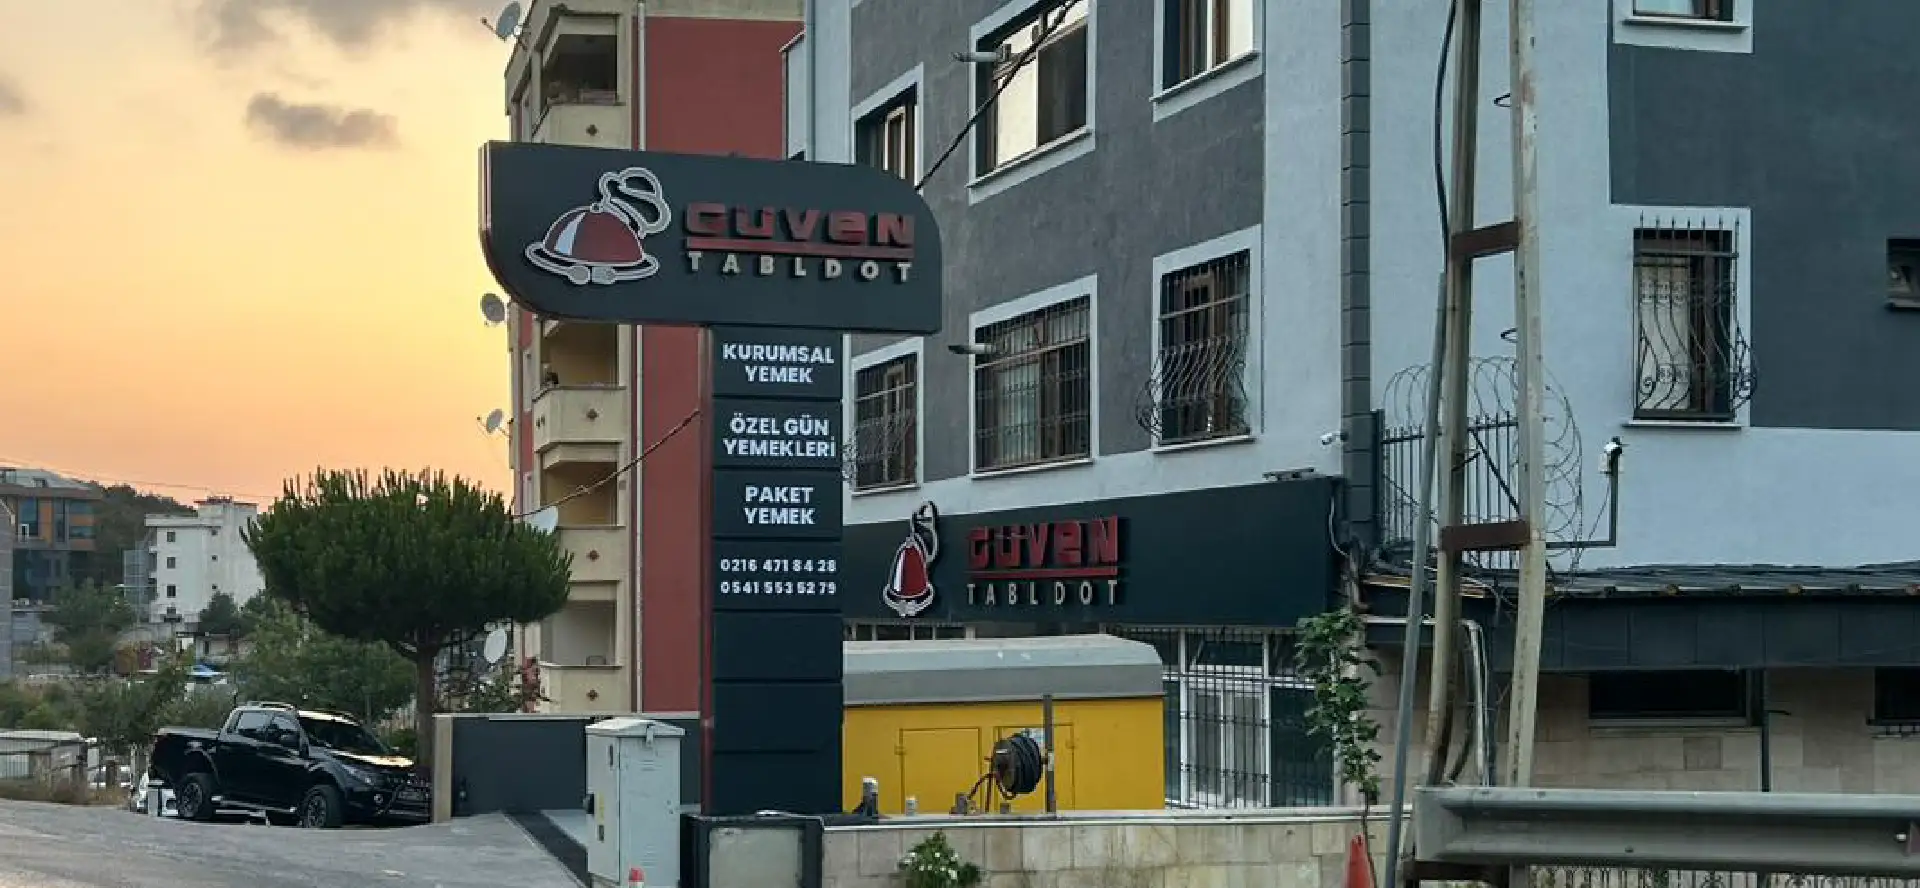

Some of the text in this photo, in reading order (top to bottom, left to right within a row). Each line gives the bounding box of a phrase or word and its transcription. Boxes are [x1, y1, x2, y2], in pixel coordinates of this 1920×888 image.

[688, 251, 912, 282] TABLDOT
[722, 344, 835, 364] KURUMSAL
[744, 365, 814, 383] YEMEK
[730, 412, 831, 436] ÖZEL GÜN
[722, 435, 836, 457] YEMEKLERİ
[745, 486, 814, 504] PAKET
[744, 507, 816, 525] YEMEK
[720, 558, 837, 572] 0216 471 84 28
[720, 581, 760, 594] 0541
[763, 581, 794, 594] 553
[819, 581, 837, 594] 79
[966, 579, 1118, 606] TABLDOT
